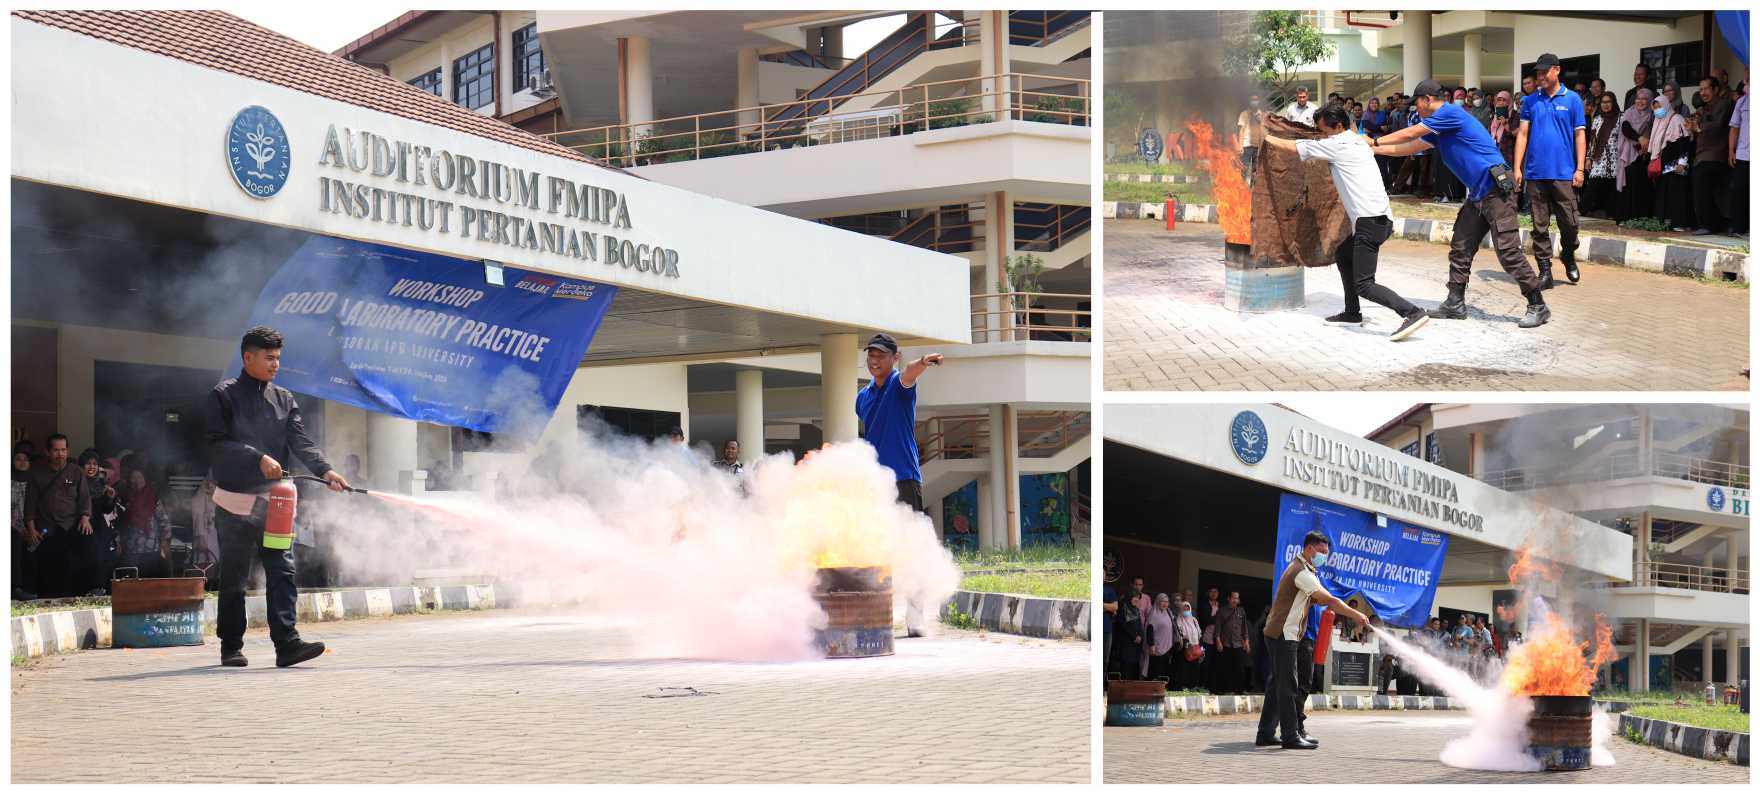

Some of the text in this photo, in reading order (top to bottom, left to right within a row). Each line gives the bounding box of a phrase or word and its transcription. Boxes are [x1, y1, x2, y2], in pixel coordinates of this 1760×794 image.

[245, 178, 274, 194] BOGOR
[318, 122, 633, 230] AUDITORIUM FMIPA
[318, 176, 680, 278] INSTITUT PERTANIAN BOGOR
[388, 278, 485, 310] WORKSHOP
[273, 291, 550, 362] GOOD LABORATORY PRACTICE
[1284, 425, 1409, 487] AUDITORIUM
[1412, 467, 1459, 504] FMIPA
[1282, 455, 1485, 533] INSTITUT PERTANIAN BOGOR
[1339, 530, 1391, 556] WORKSHOP
[1358, 580, 1396, 594] UNIVERSITY
[1382, 563, 1432, 587] PRACTICE
